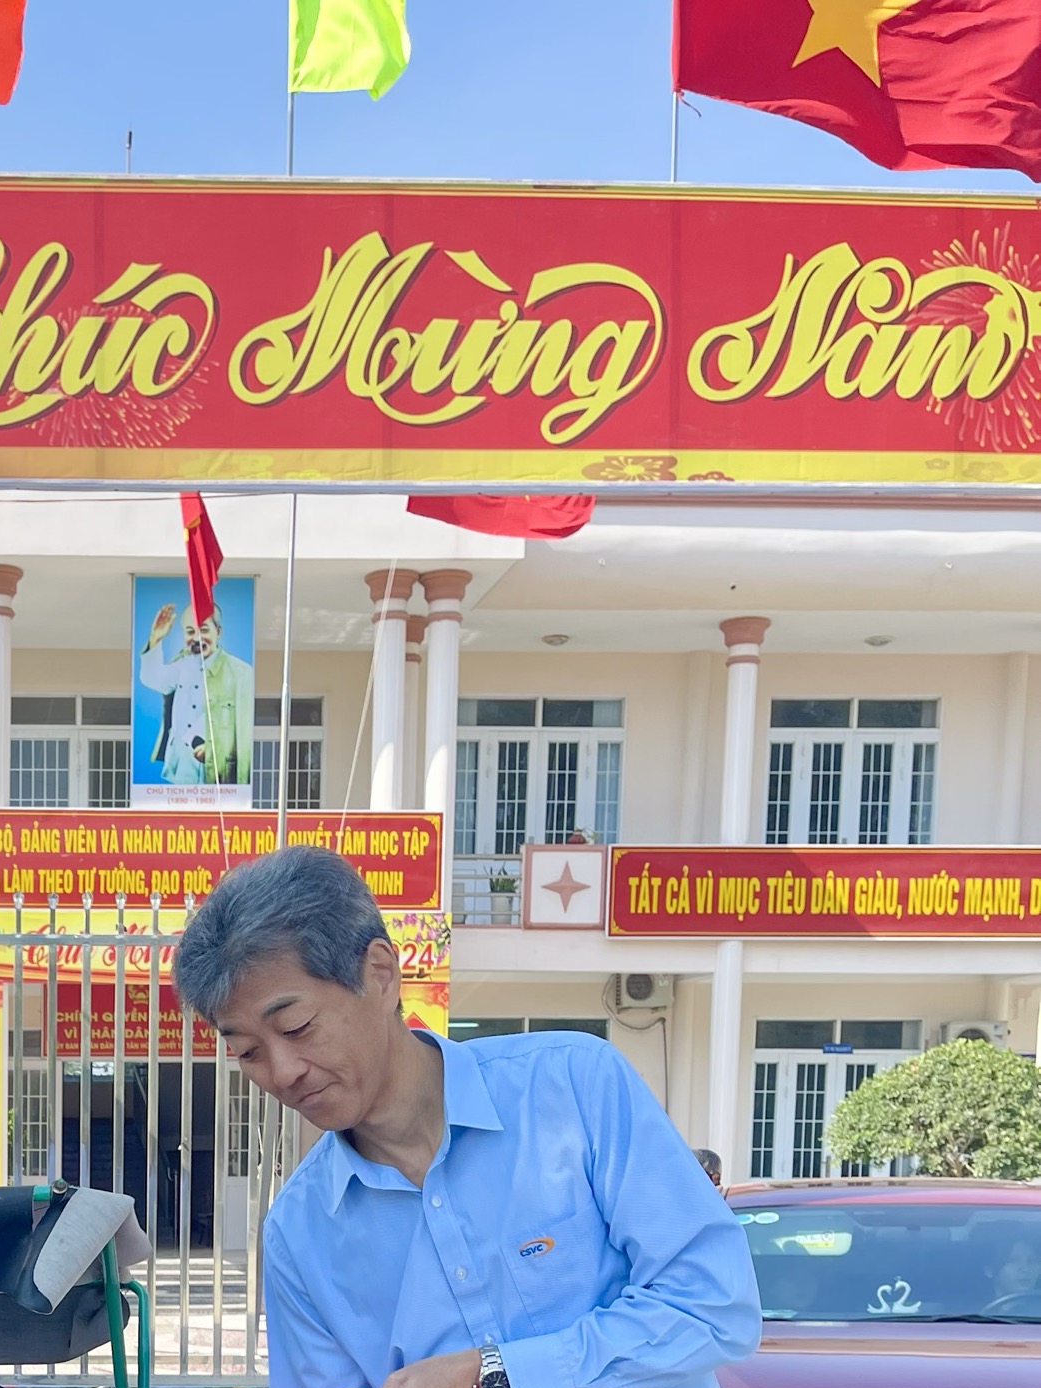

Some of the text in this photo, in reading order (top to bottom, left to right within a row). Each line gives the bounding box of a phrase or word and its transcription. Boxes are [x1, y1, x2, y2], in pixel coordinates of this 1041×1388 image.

[228, 231, 662, 444] Mừng
[21, 820, 60, 853] ĐẢNG
[64, 824, 97, 853] VIÊN
[101, 824, 119, 853] VÀ
[123, 824, 163, 854] NHÂN
[167, 825, 197, 854] DÂN
[201, 826, 220, 854] XÃ
[224, 826, 252, 855] TÂN
[255, 825, 276, 854] HÒ
[335, 825, 366, 855] TÂM
[370, 831, 399, 860] HỌC
[403, 827, 430, 860] TẬP
[3, 863, 34, 893] LÀM
[38, 868, 74, 894] THEO
[77, 867, 97, 894] TƯ
[98, 861, 149, 897] TƯỞNG,
[151, 869, 180, 899] ĐẠO
[365, 870, 404, 896] MINH
[628, 862, 1041, 922] TẤT CẢ VÌ MỤC TIÊU DÂN GIÀU, NƯỚC MẠNH, D
[102, 1007, 148, 1022] QYỀN
[159, 1028, 195, 1042] PHỤ
